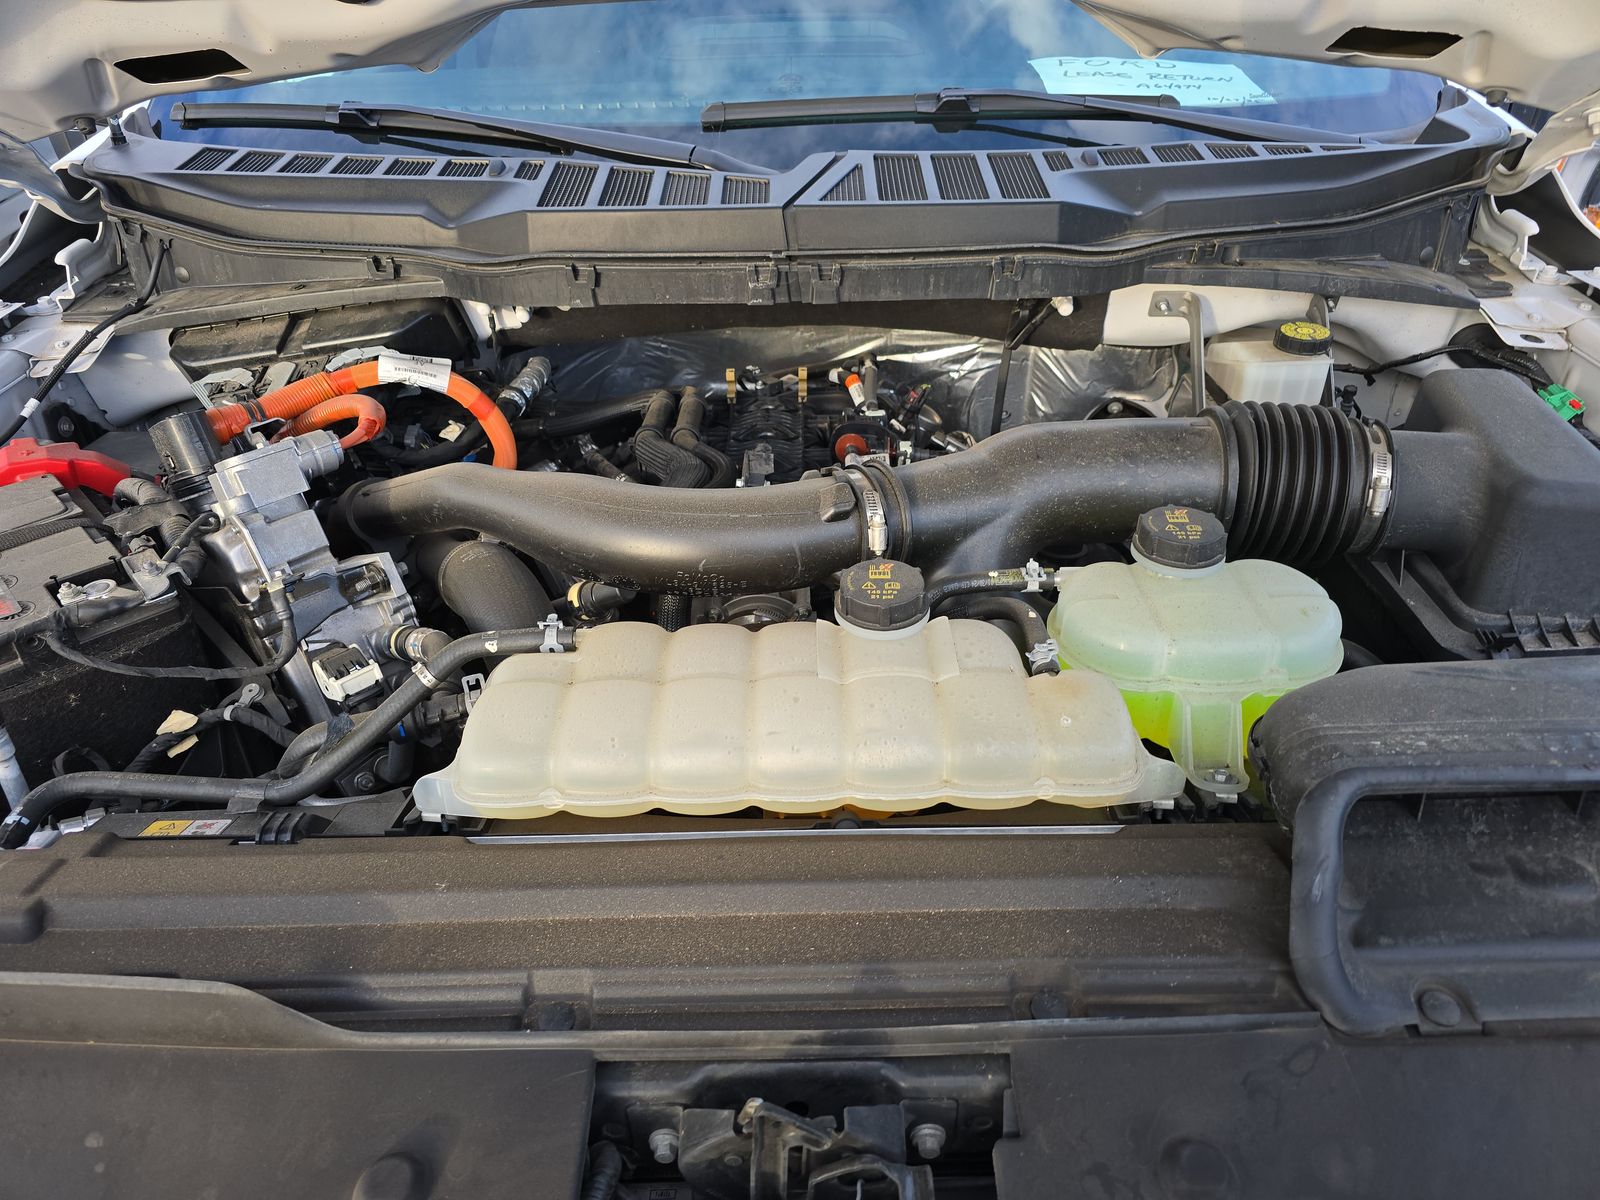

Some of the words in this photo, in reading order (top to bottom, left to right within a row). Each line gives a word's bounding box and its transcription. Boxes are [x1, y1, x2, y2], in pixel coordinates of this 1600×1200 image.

[1058, 58, 1177, 69] FORD
[1063, 69, 1133, 79] LEASE
[1146, 72, 1233, 83] RETURN
